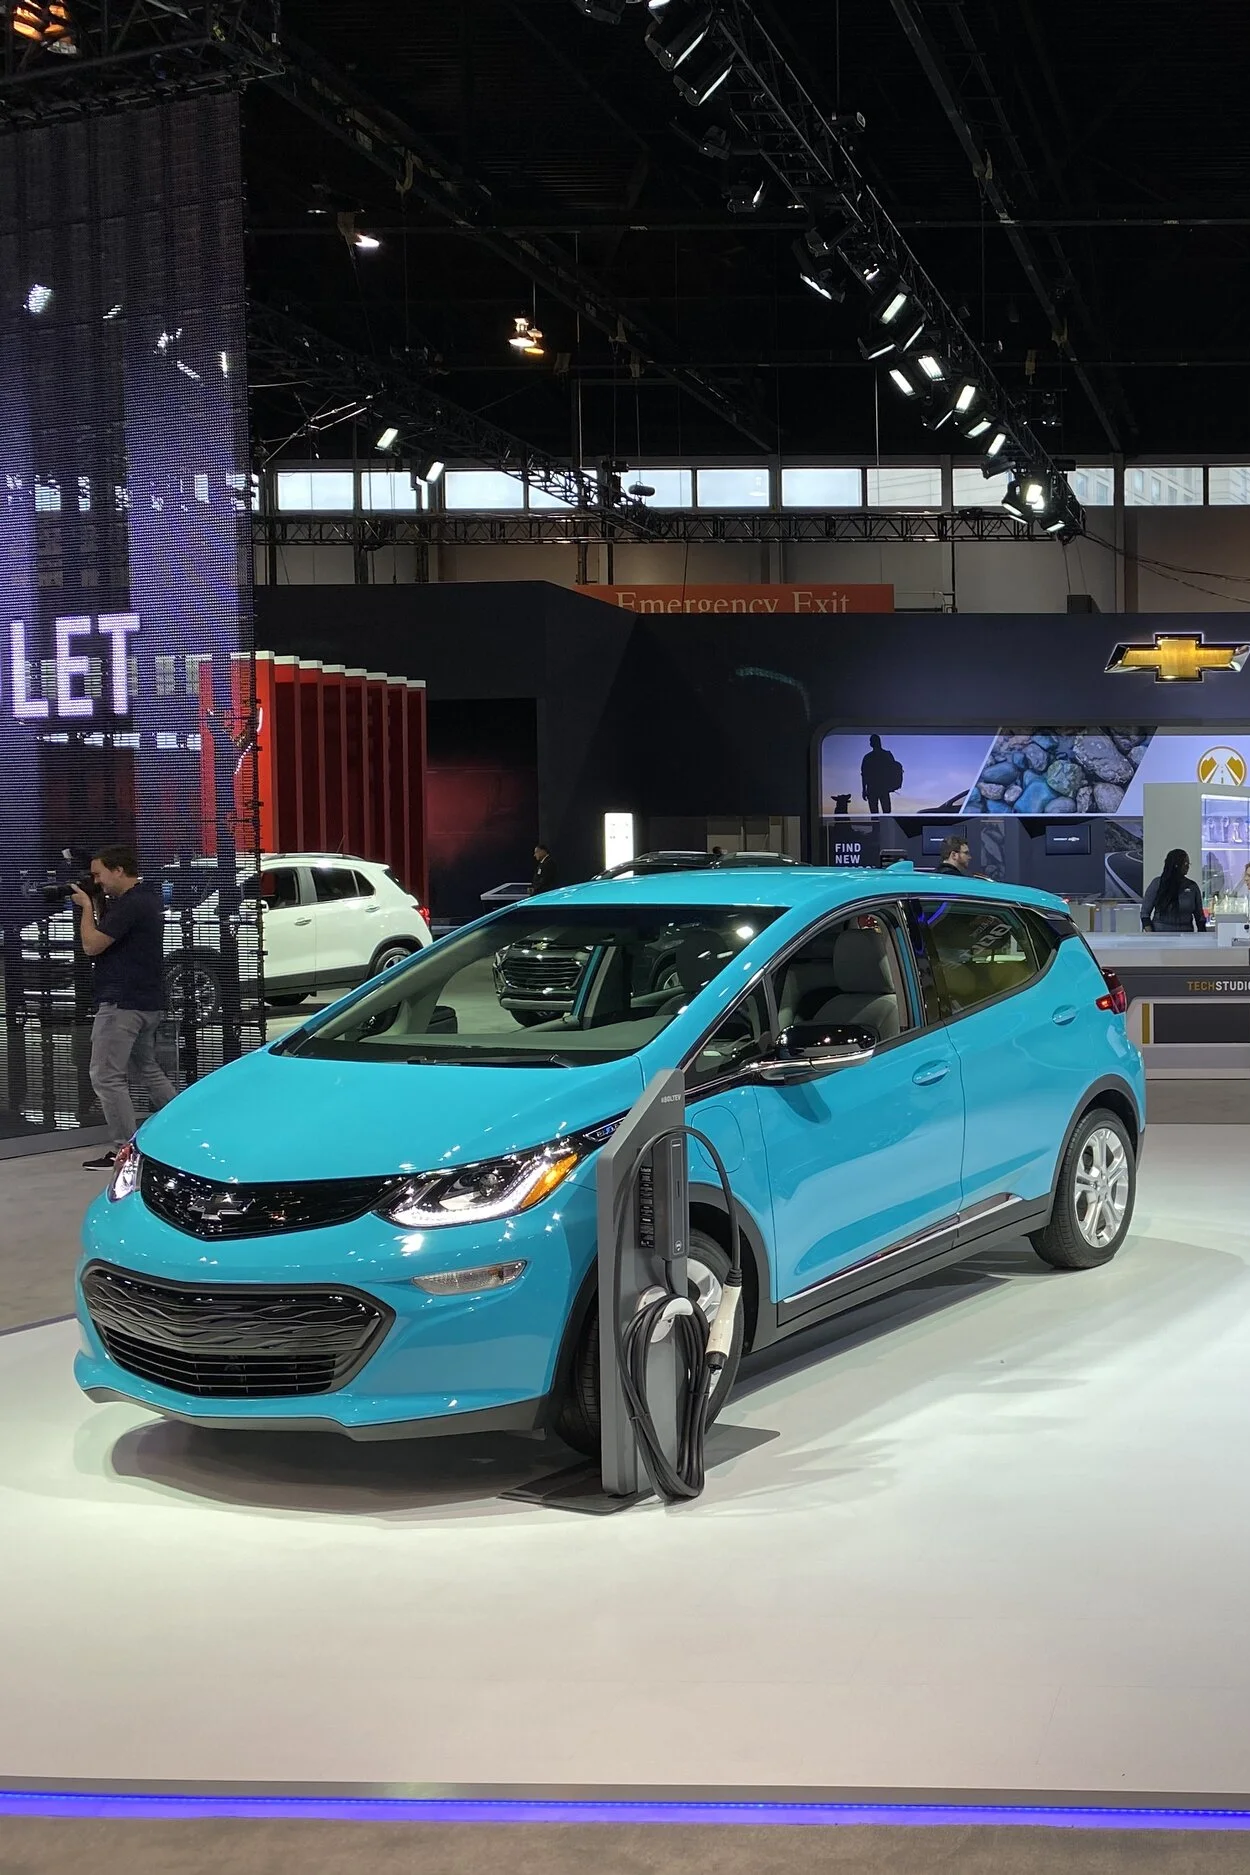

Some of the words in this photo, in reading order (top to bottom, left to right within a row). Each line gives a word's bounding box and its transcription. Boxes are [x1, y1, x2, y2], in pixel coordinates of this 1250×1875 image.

[791, 591, 850, 613] Exit
[10, 613, 140, 718] LET
[835, 843, 861, 853] FIND
[835, 854, 860, 864] NEW
